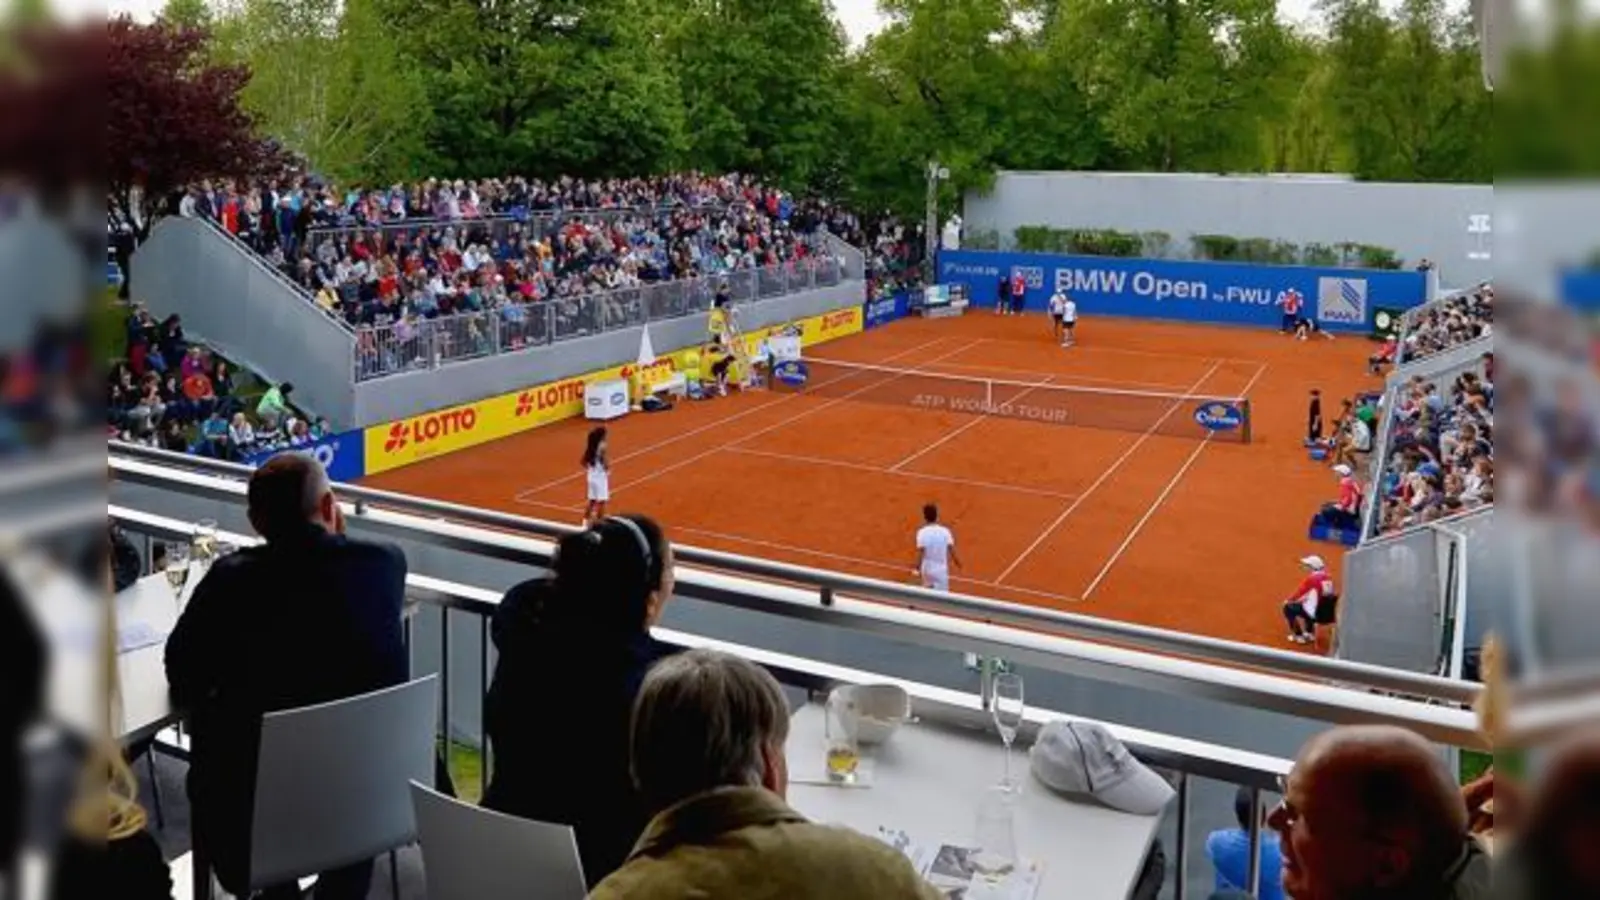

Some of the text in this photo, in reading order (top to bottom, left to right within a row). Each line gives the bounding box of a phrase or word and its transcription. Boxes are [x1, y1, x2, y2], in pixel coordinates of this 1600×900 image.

[1054, 268, 1126, 294] BMW
[1133, 273, 1207, 301] Open
[1227, 286, 1271, 305] FWU
[910, 394, 945, 407] ATP
[1019, 404, 1068, 421] TOUR
[414, 408, 477, 442] LOTTO
